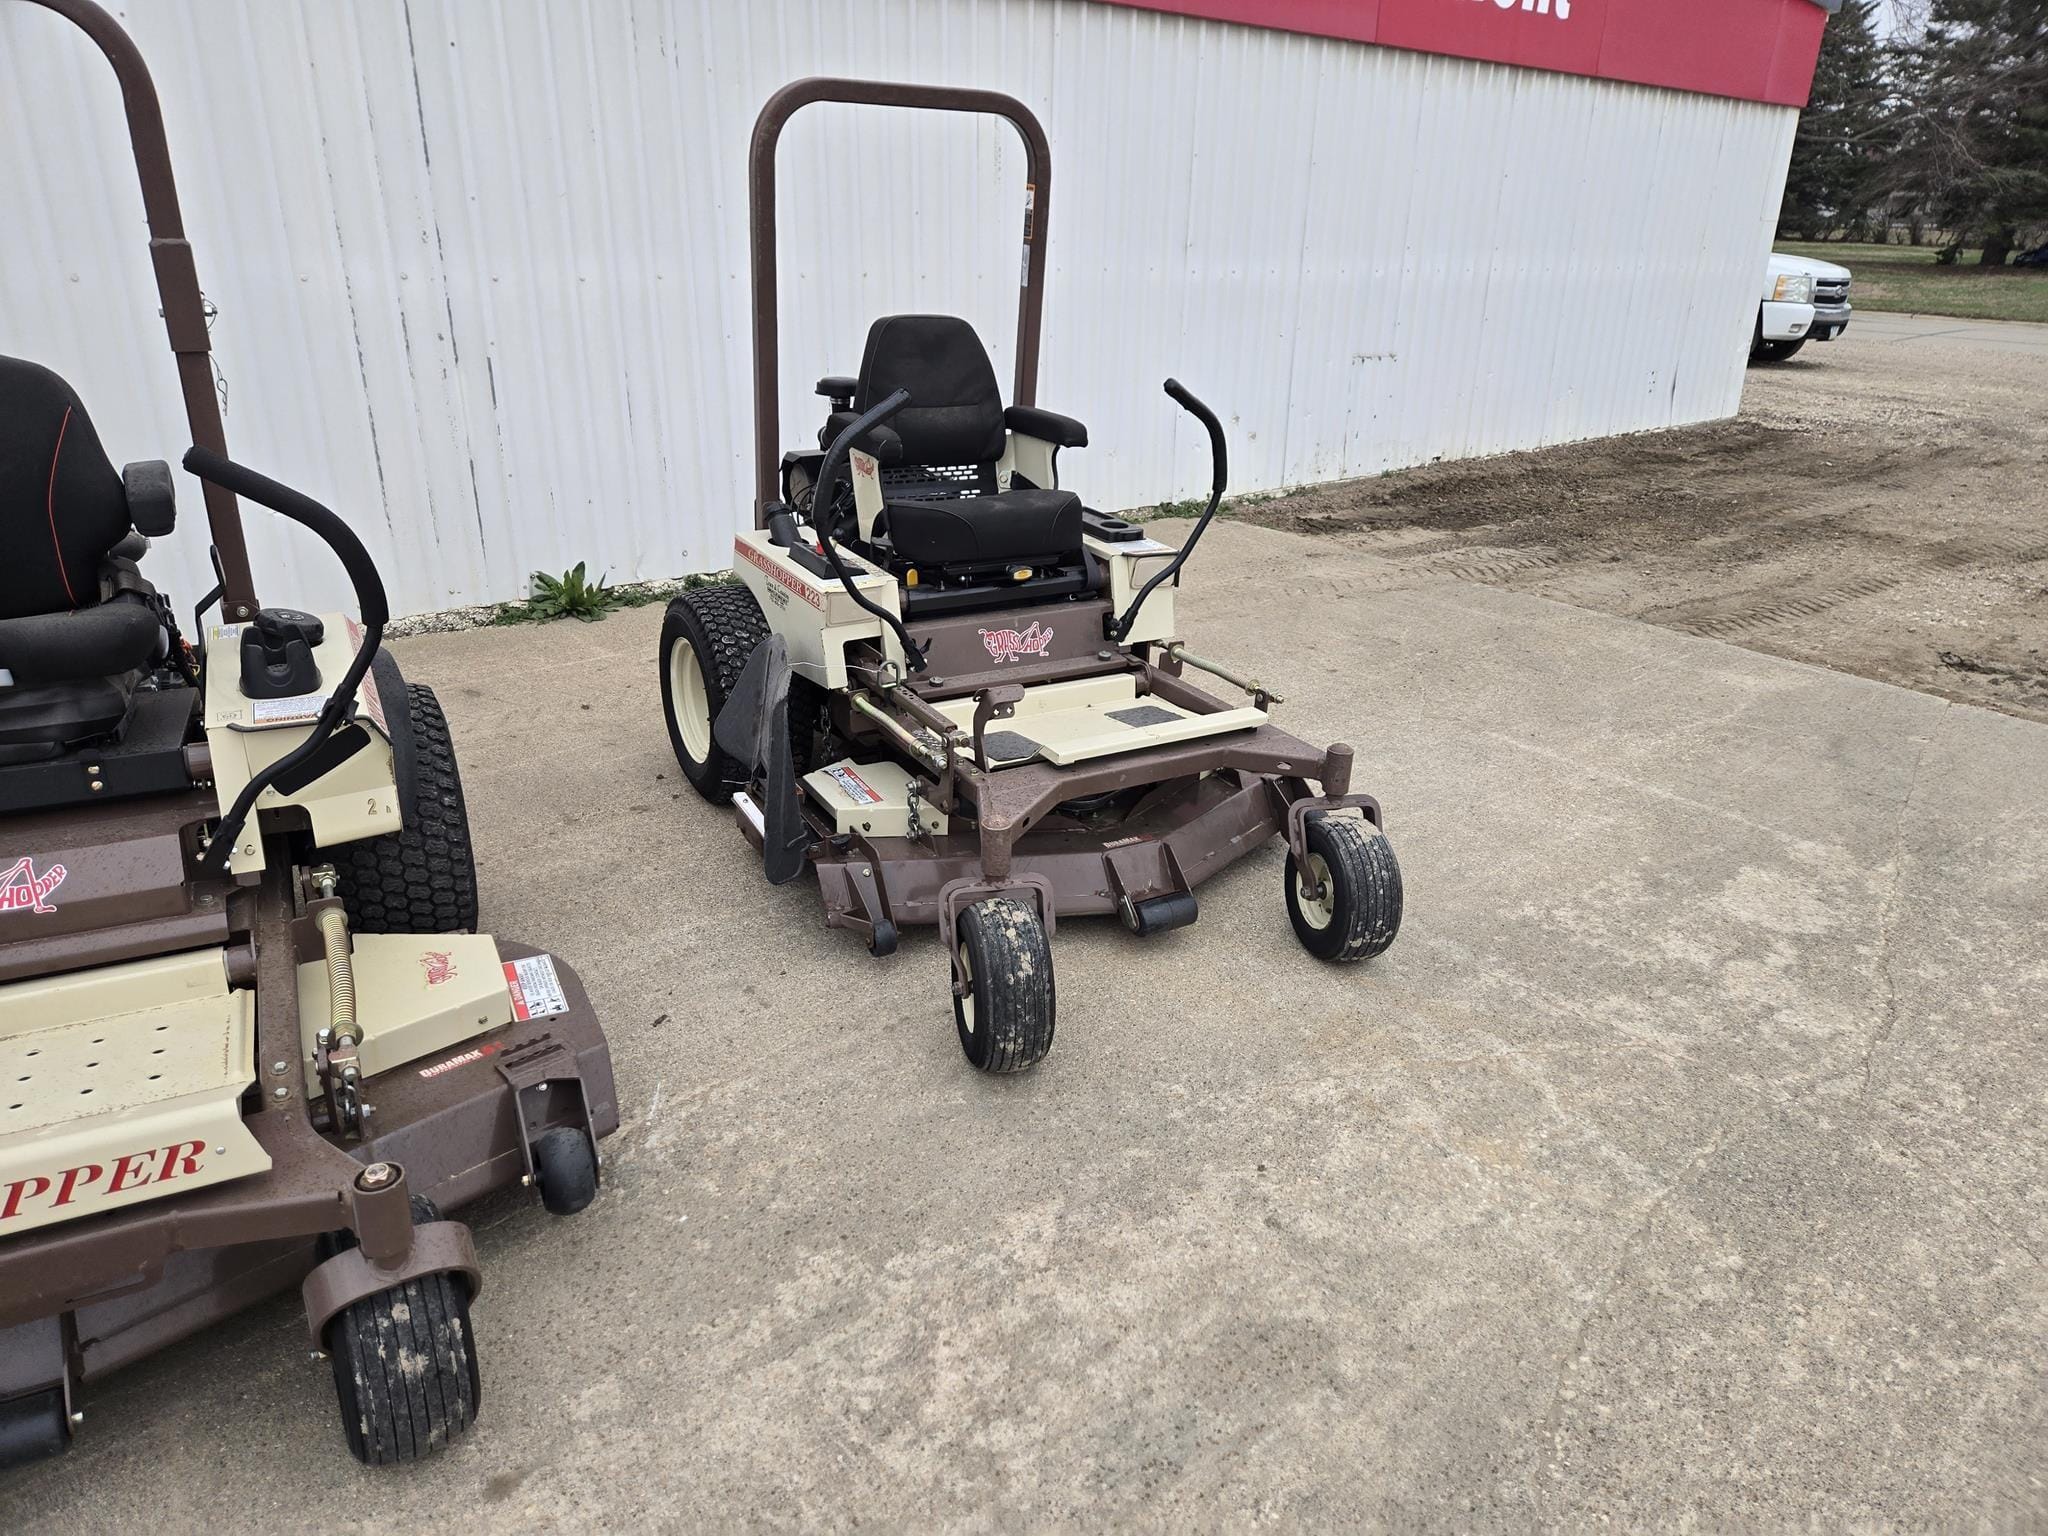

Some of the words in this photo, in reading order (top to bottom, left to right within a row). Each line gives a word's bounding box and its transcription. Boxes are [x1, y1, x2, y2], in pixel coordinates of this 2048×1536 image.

[748, 549, 802, 593] GRASSHOPPER
[806, 587, 821, 607] 223
[0, 1139, 207, 1220] PPER
